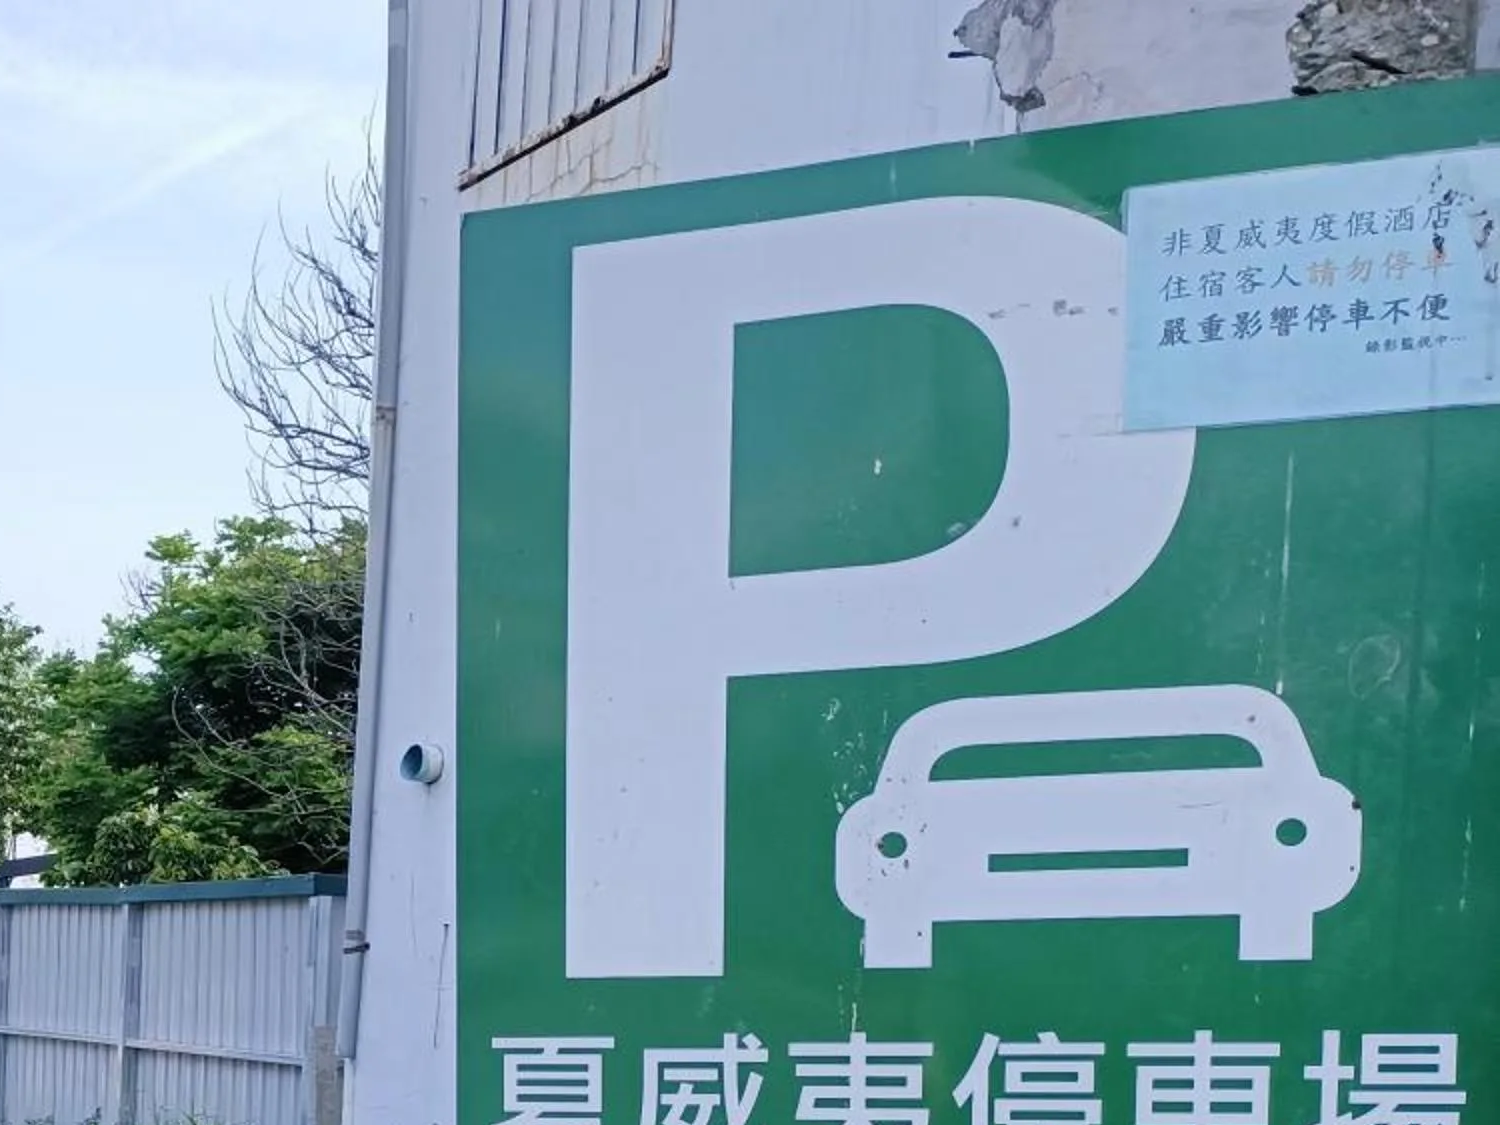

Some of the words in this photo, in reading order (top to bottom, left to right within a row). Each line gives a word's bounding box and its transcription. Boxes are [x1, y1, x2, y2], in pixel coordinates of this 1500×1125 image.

[1162, 205, 1450, 256] 非夏威夷度假酒店
[1158, 292, 1450, 347] 嚴重影響停車不便
[565, 195, 1196, 978] P
